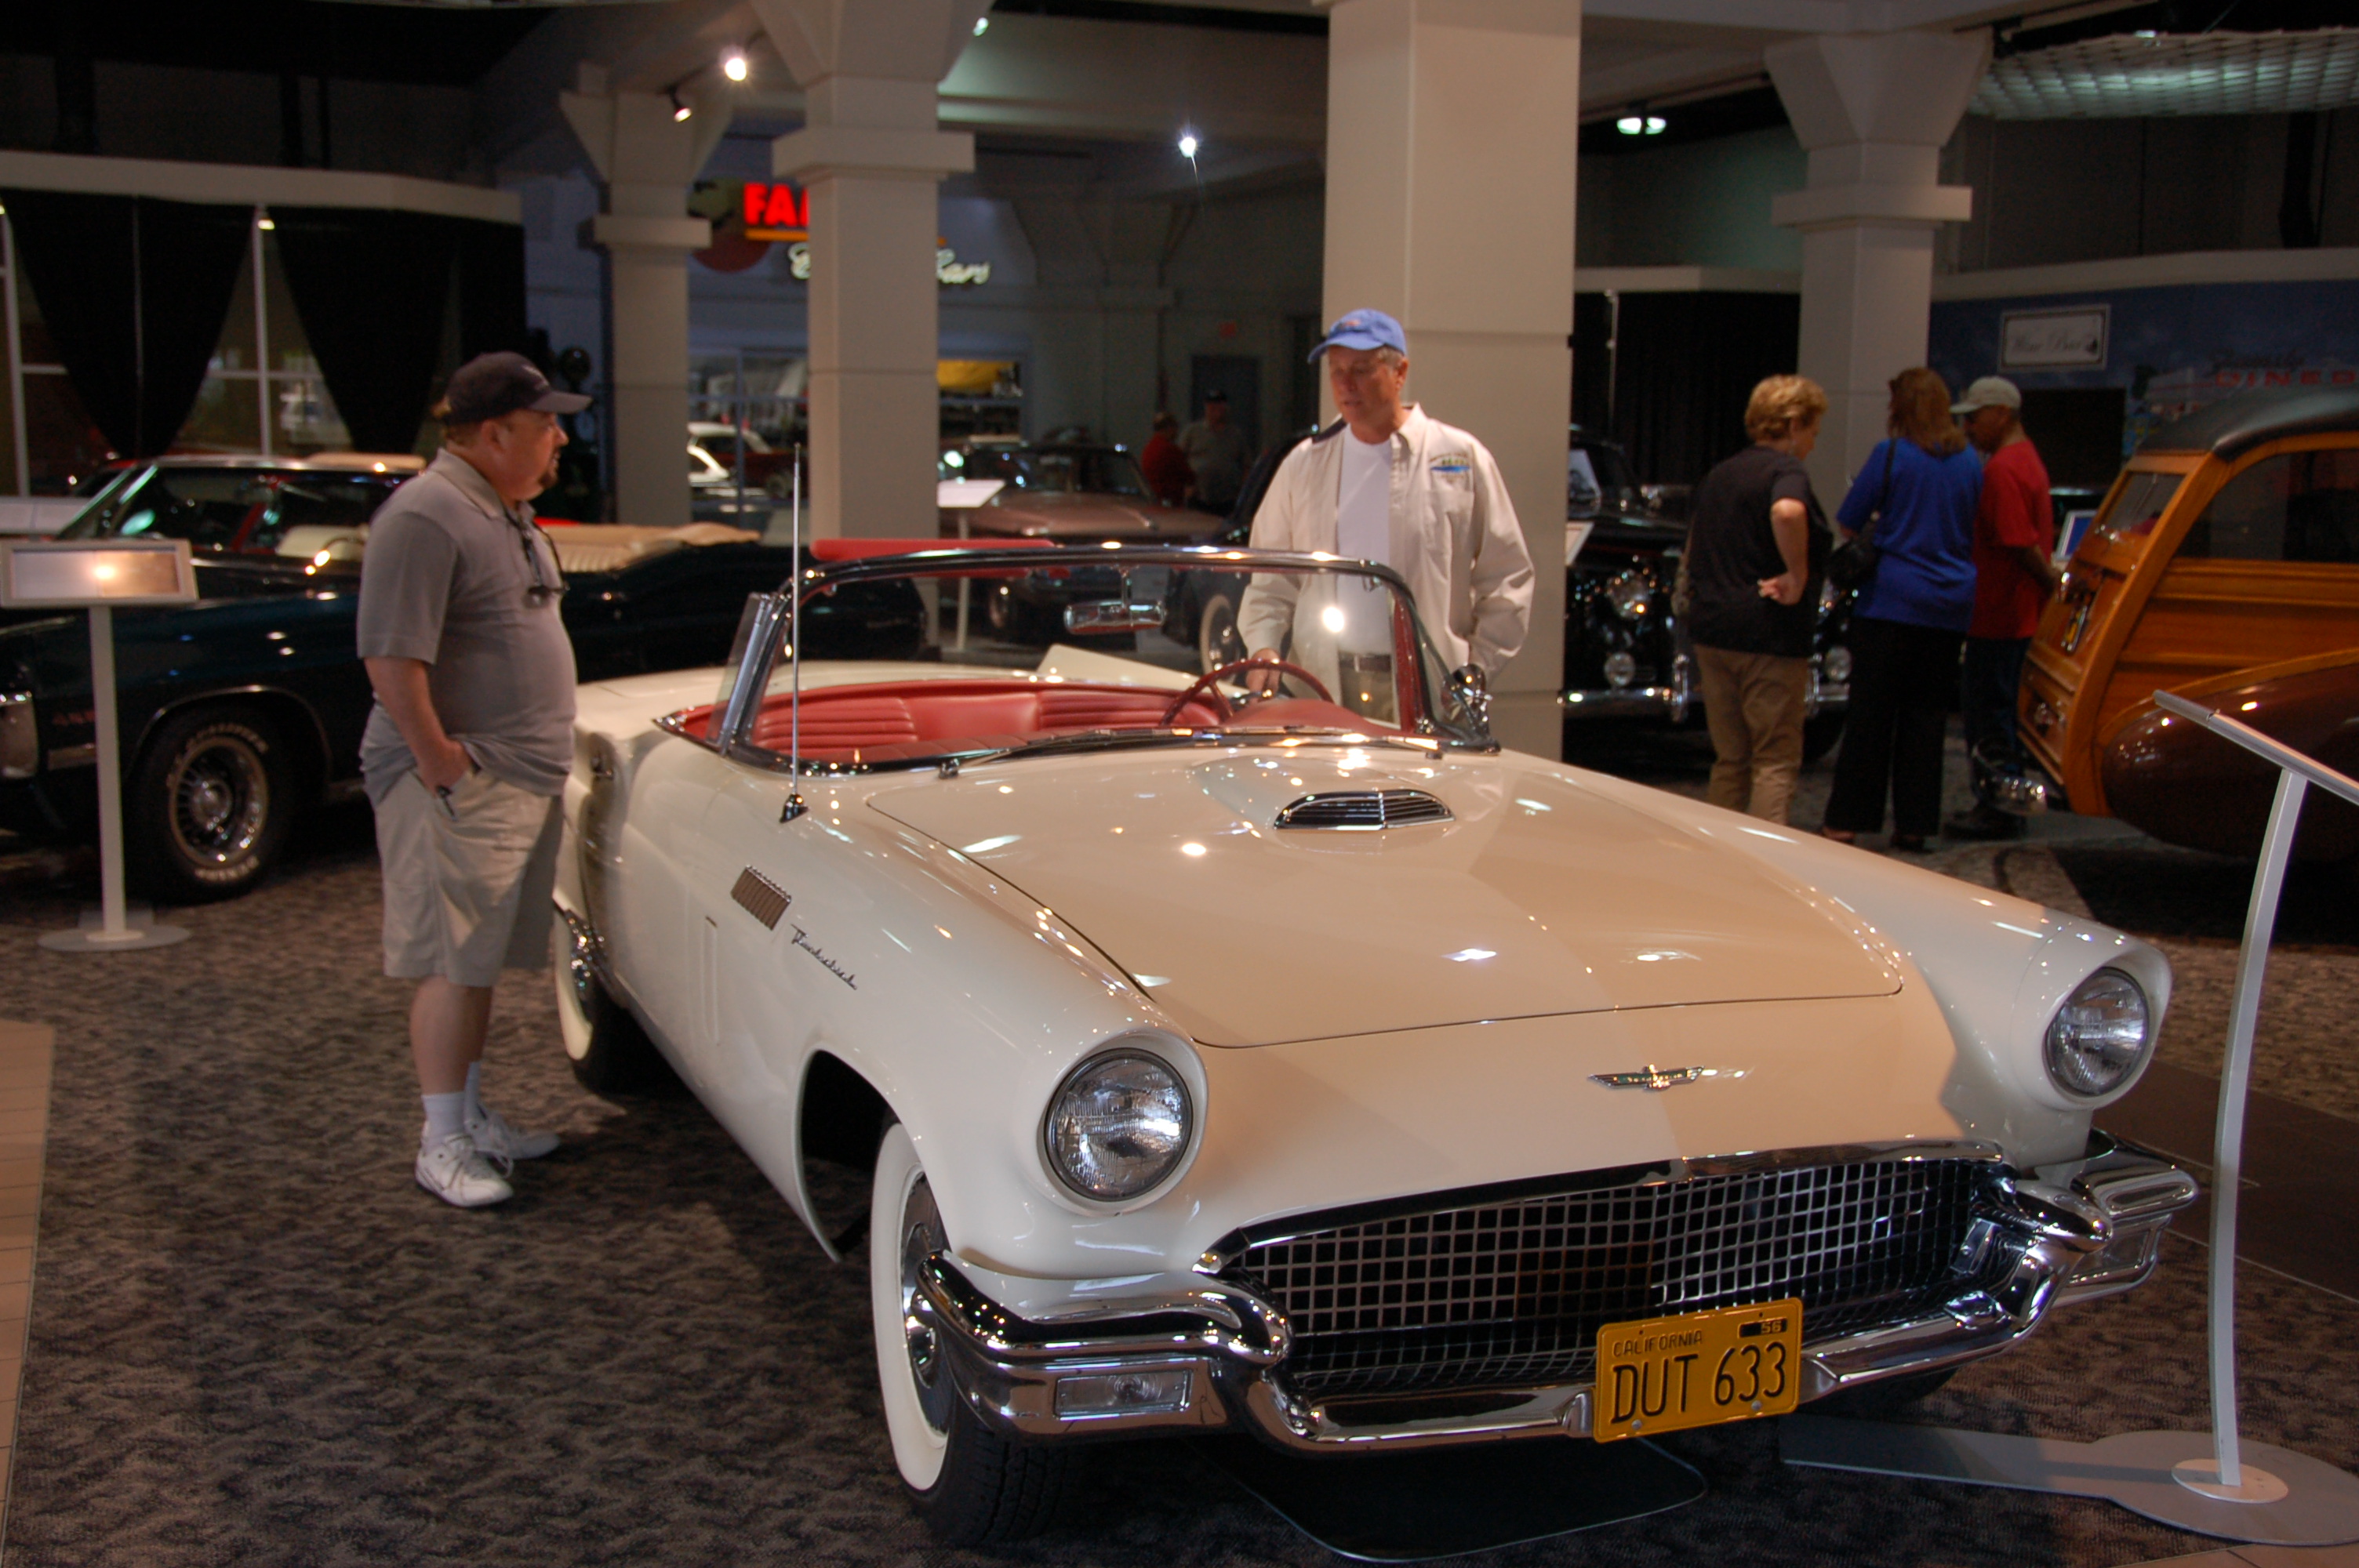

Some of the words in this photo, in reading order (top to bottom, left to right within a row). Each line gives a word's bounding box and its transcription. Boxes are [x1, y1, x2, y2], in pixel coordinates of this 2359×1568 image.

[1761, 1320, 1783, 1334] 56
[1613, 1330, 1703, 1357] CALIFORNIA
[1610, 1353, 1699, 1424] DUT
[1714, 1341, 1787, 1406] 633
